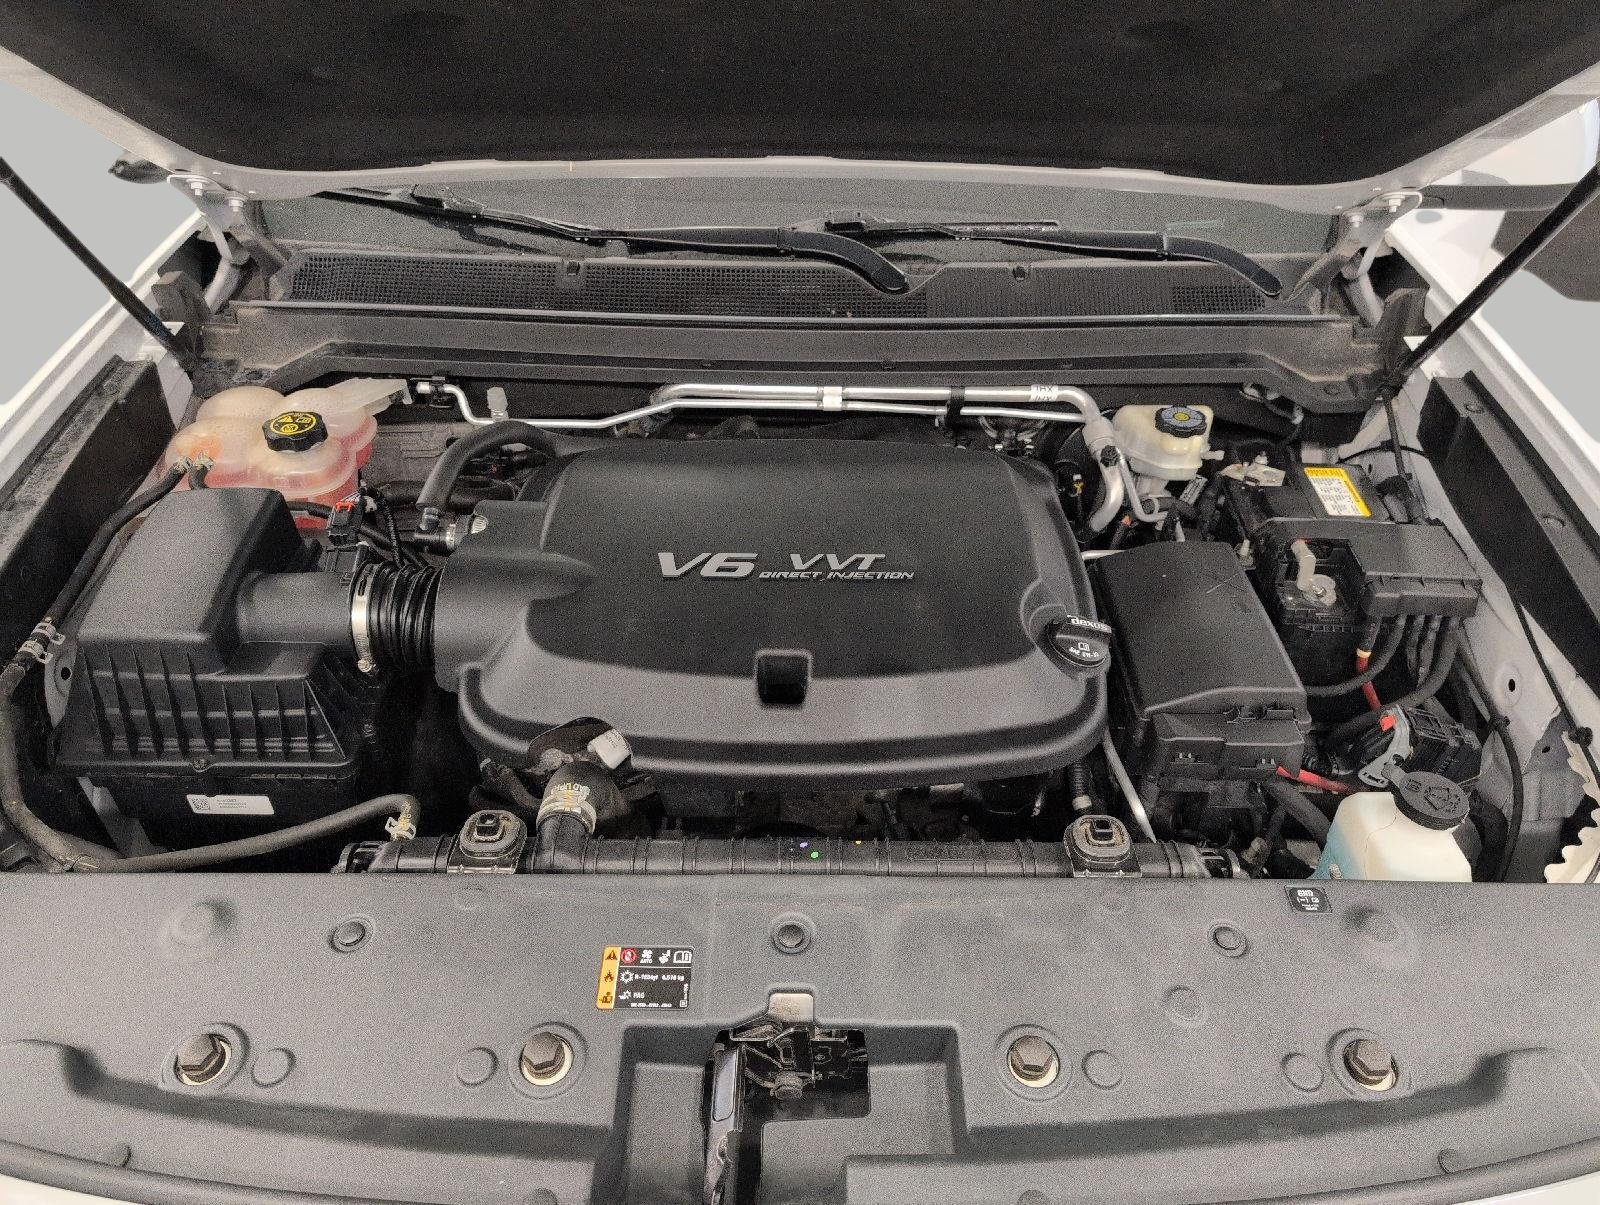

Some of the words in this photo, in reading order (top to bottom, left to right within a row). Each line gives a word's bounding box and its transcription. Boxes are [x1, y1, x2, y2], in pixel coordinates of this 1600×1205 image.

[657, 552, 758, 578] V6
[789, 553, 886, 570] VVT
[758, 571, 822, 580] DIRECT
[827, 571, 915, 580] INJECTION
